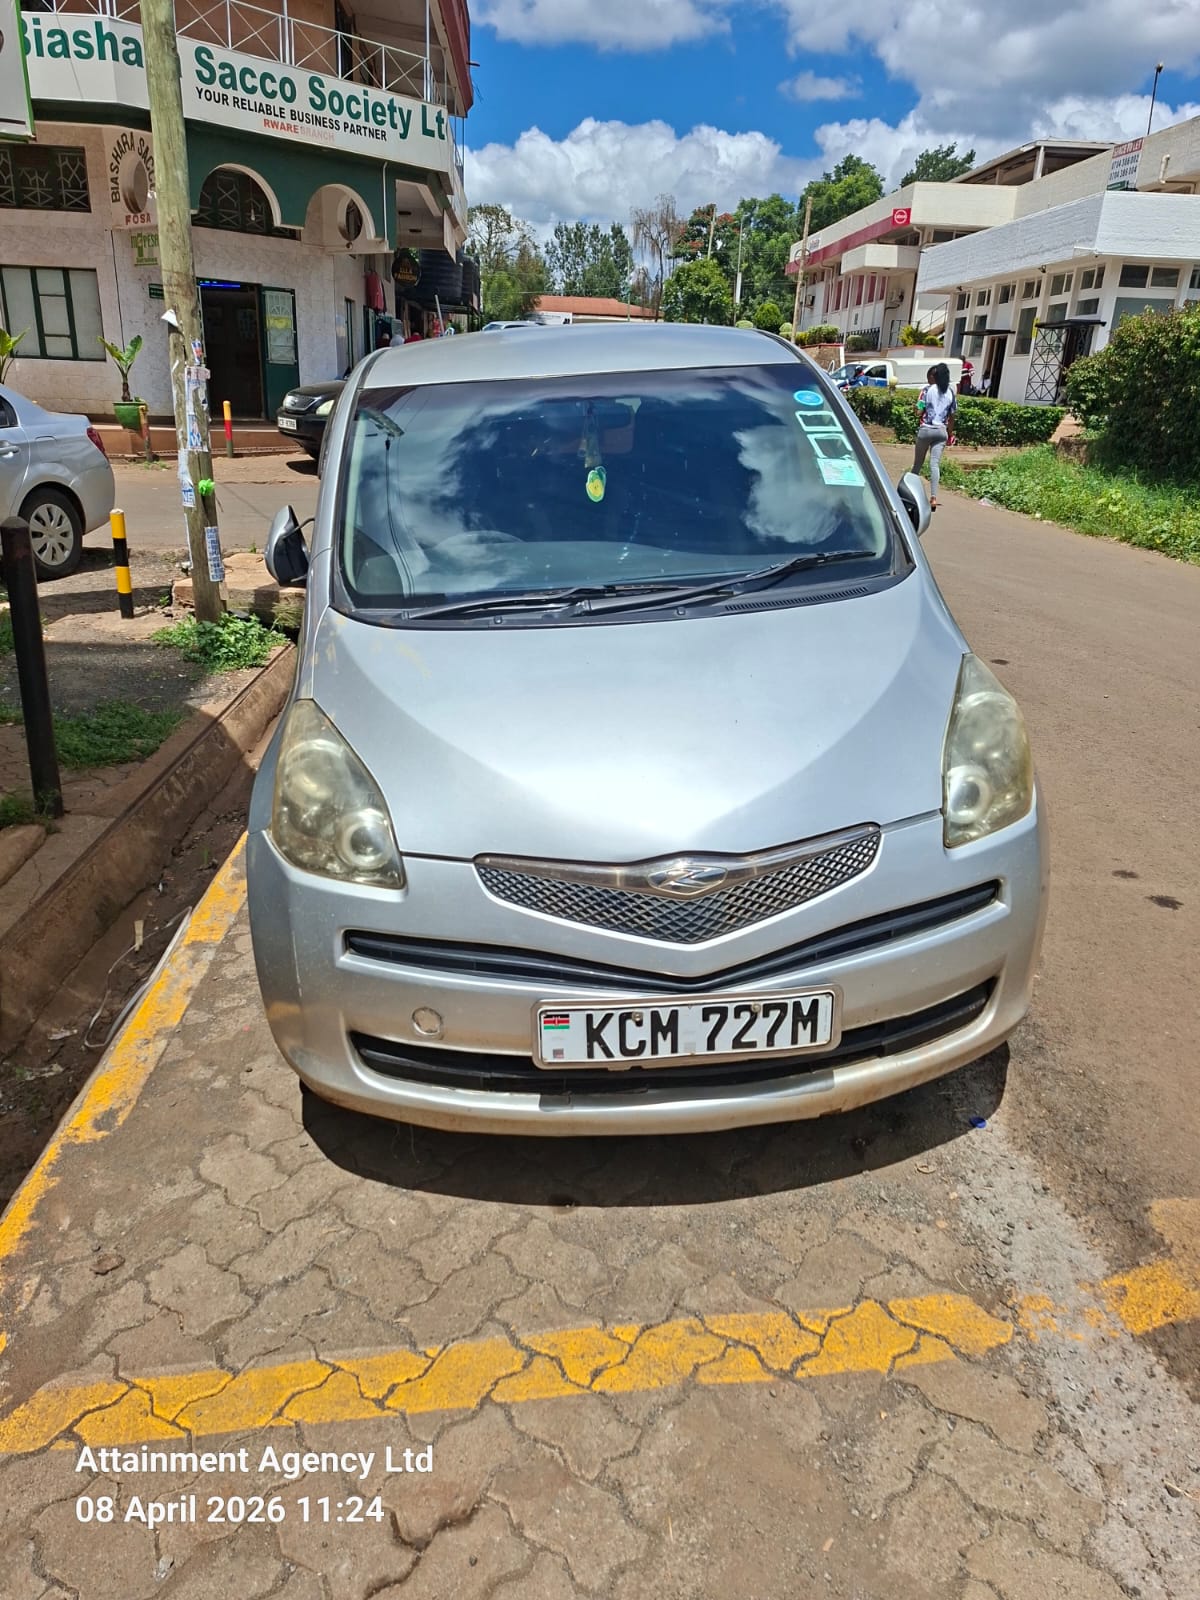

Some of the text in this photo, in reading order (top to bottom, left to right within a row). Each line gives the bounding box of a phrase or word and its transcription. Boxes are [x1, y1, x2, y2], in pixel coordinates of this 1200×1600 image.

[195, 46, 296, 103] Sacco
[308, 75, 412, 140] Society
[421, 105, 447, 141] Lt
[195, 86, 388, 141] YOUR RELIABLE BUSINESS PARTNER
[263, 118, 300, 134] RWARE
[110, 131, 136, 203] BIASHARA
[125, 213, 152, 225] FOSA
[586, 998, 819, 1059] KCM 727M
